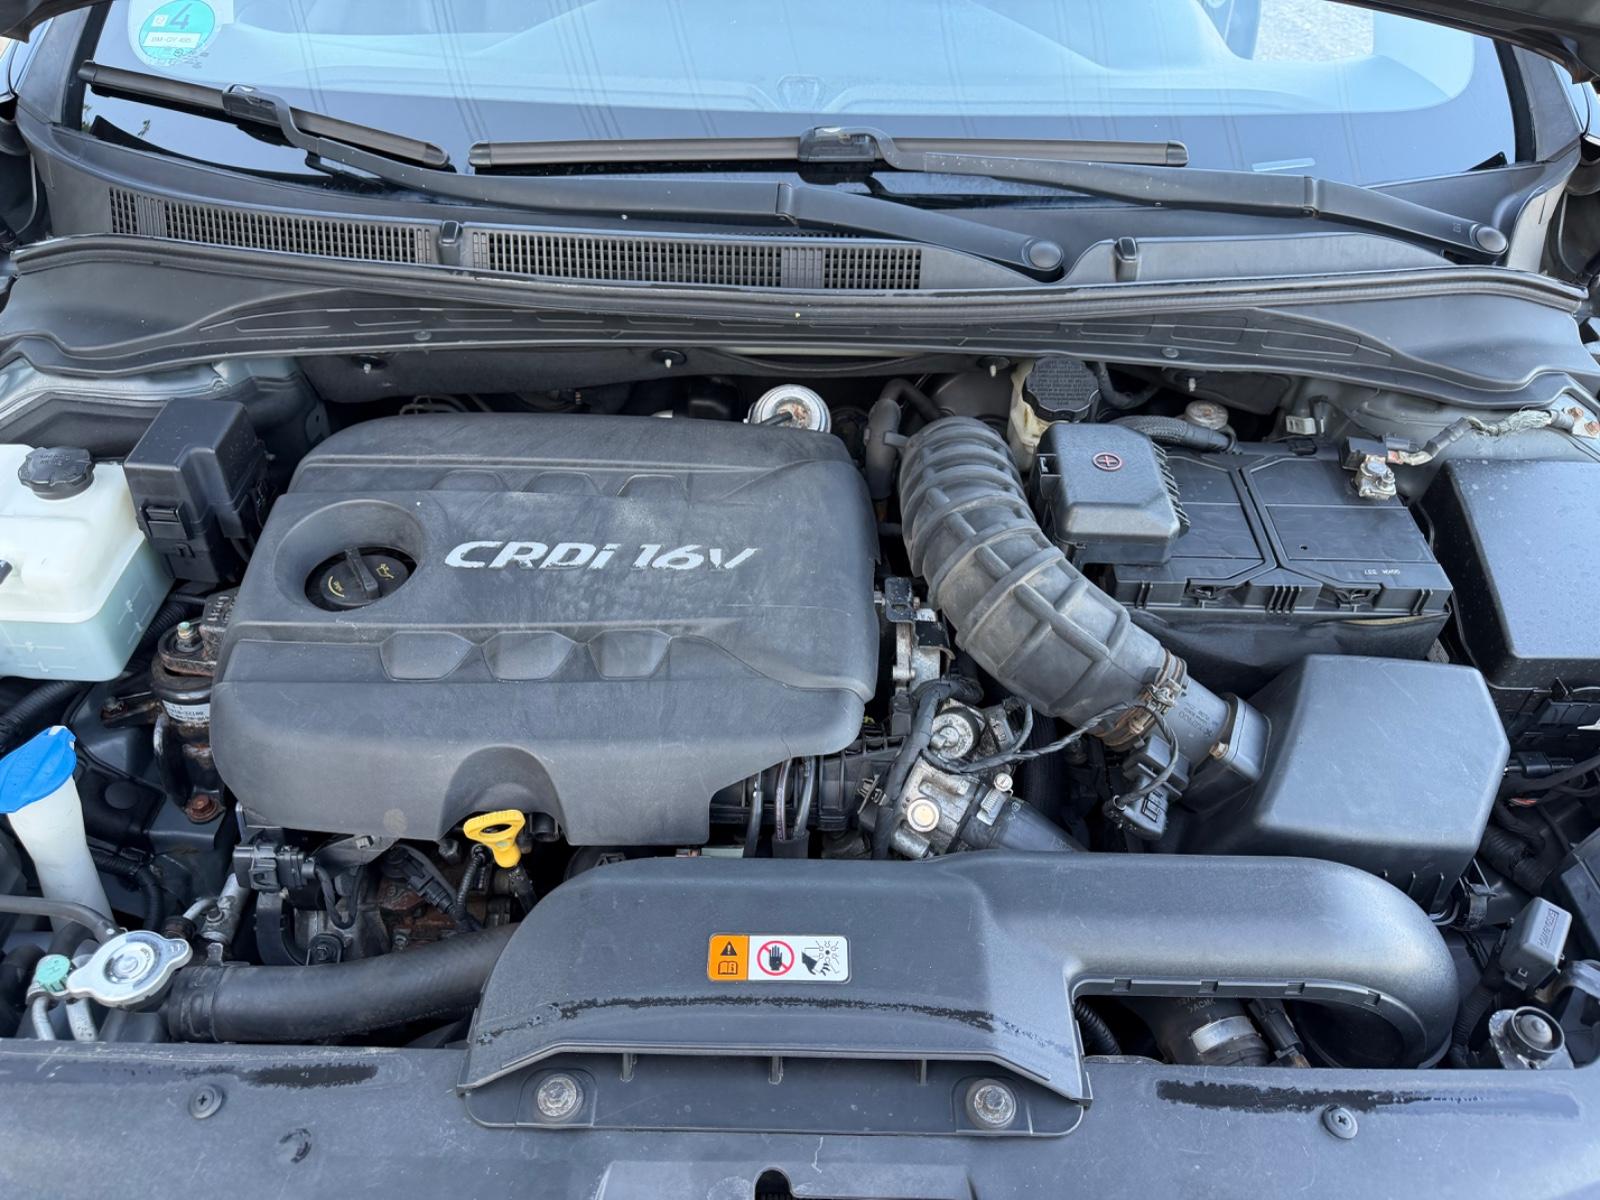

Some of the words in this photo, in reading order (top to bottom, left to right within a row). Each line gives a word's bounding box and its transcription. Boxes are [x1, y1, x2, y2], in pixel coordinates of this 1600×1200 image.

[170, 3, 193, 30] 4
[445, 541, 621, 570] CRDi
[631, 543, 762, 570] 16V
